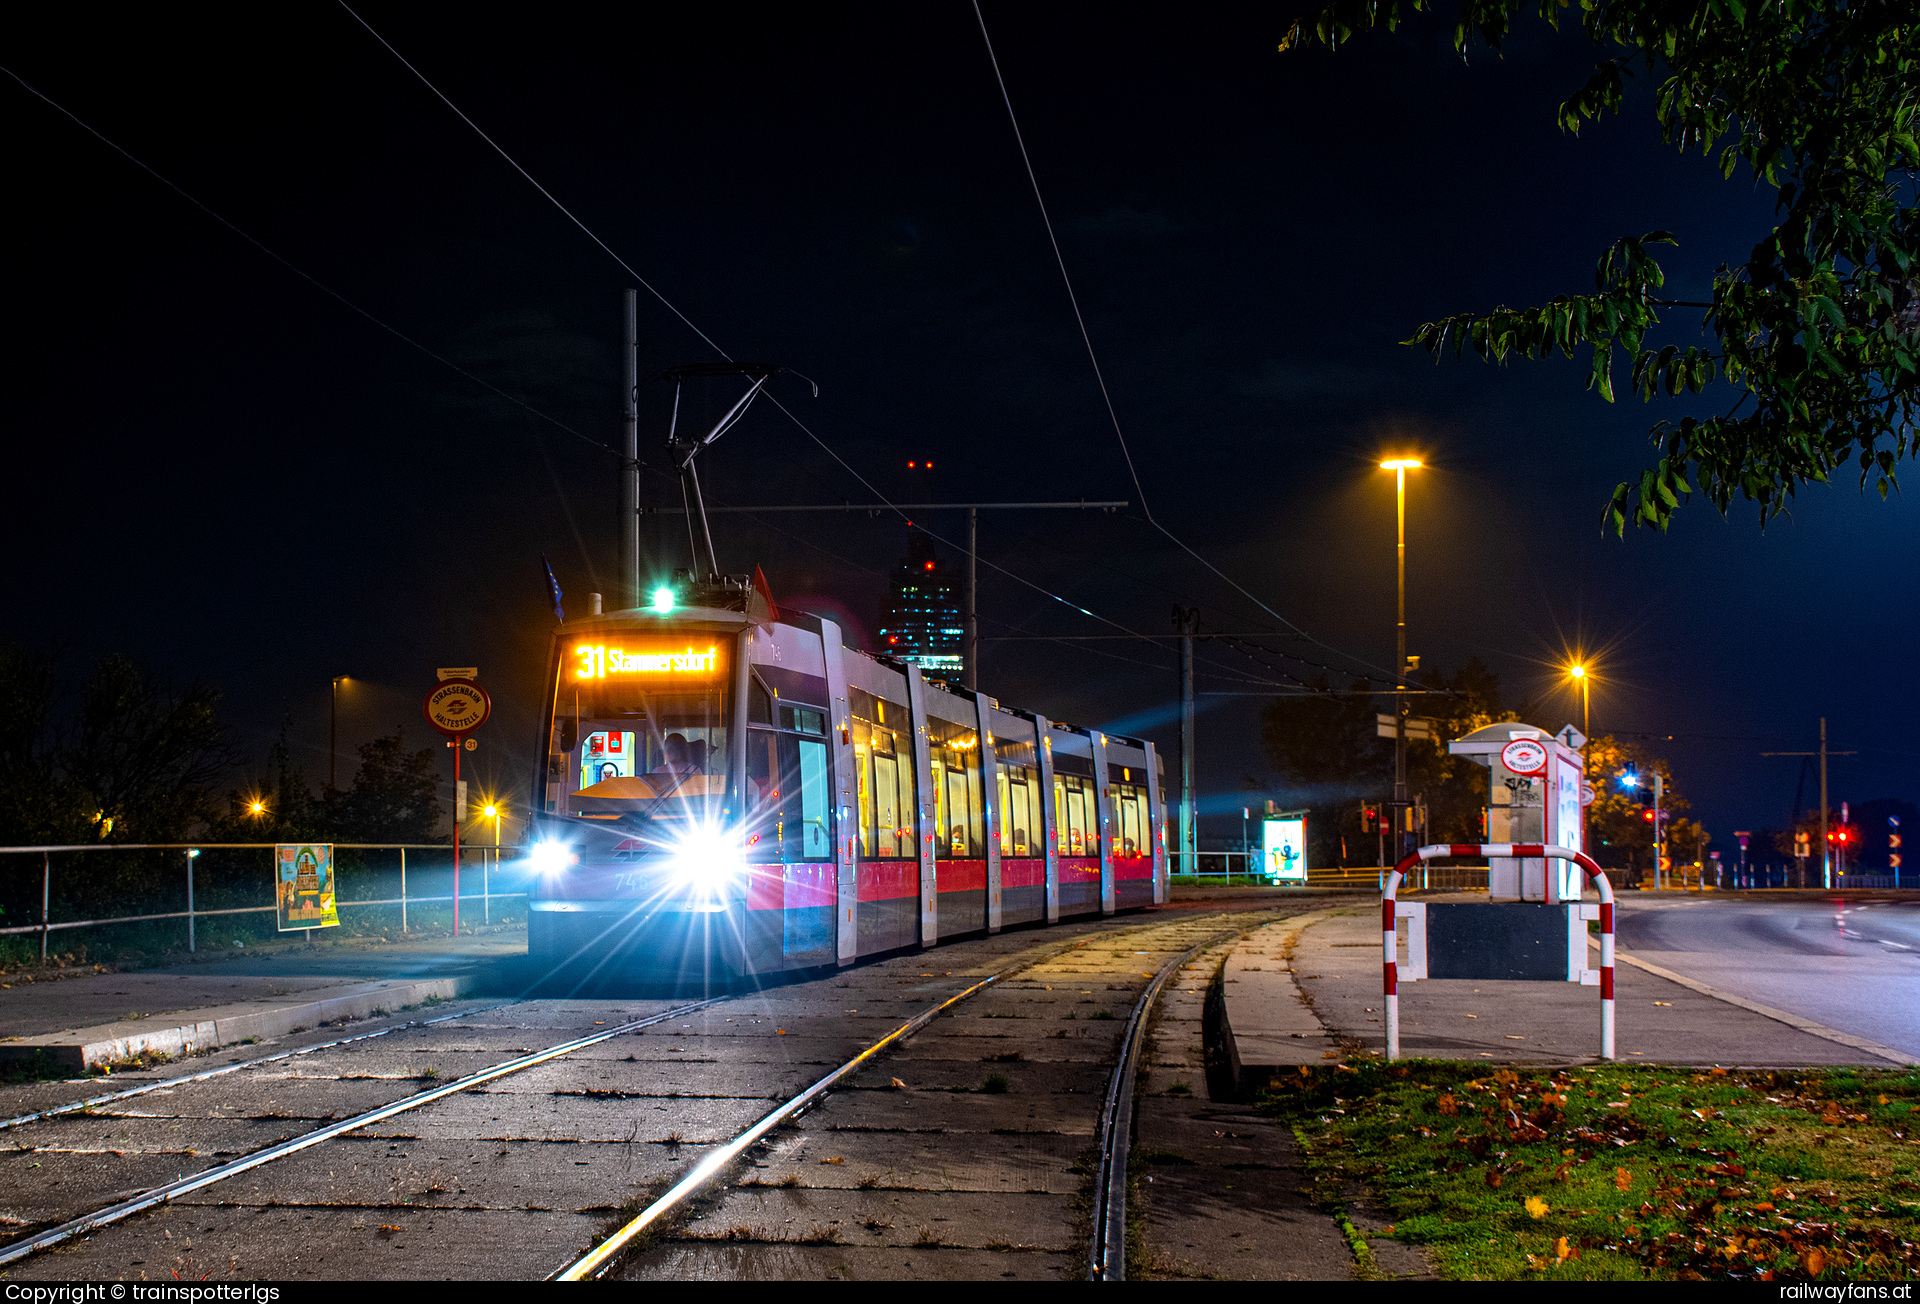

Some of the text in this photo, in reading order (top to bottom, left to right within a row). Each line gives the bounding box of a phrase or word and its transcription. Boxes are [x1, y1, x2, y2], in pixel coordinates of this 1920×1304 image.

[576, 645, 716, 679] 31 Stammersdorf
[432, 686, 482, 705] STRASSENBAHN
[434, 711, 480, 728] HALTESTELLE
[466, 741, 476, 749] 31
